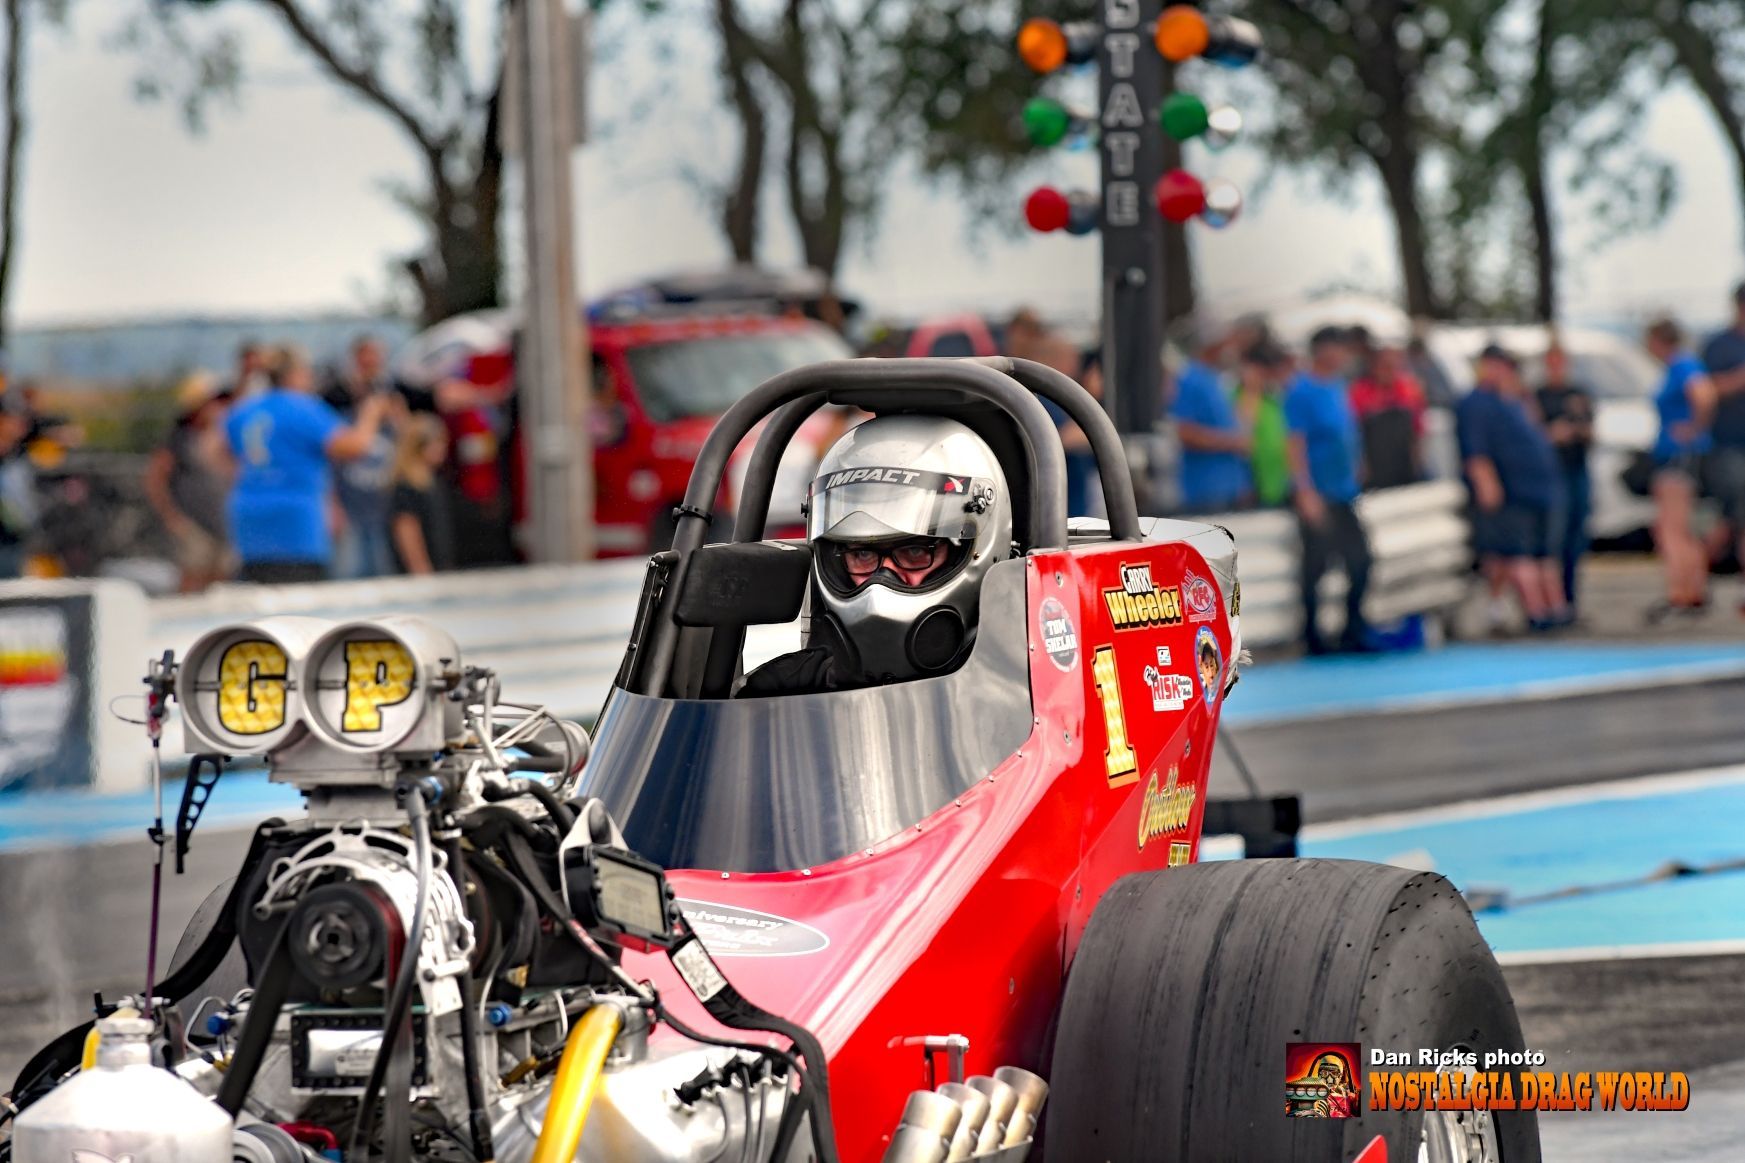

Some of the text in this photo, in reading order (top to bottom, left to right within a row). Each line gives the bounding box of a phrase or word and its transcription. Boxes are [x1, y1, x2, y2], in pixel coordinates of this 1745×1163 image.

[826, 468, 920, 490] IMPACT
[1104, 587, 1182, 626] Wheeler
[1153, 676, 1181, 700] RISK
[1093, 646, 1138, 782] 1
[1138, 768, 1196, 850] Outlaw
[683, 910, 784, 931] niversary
